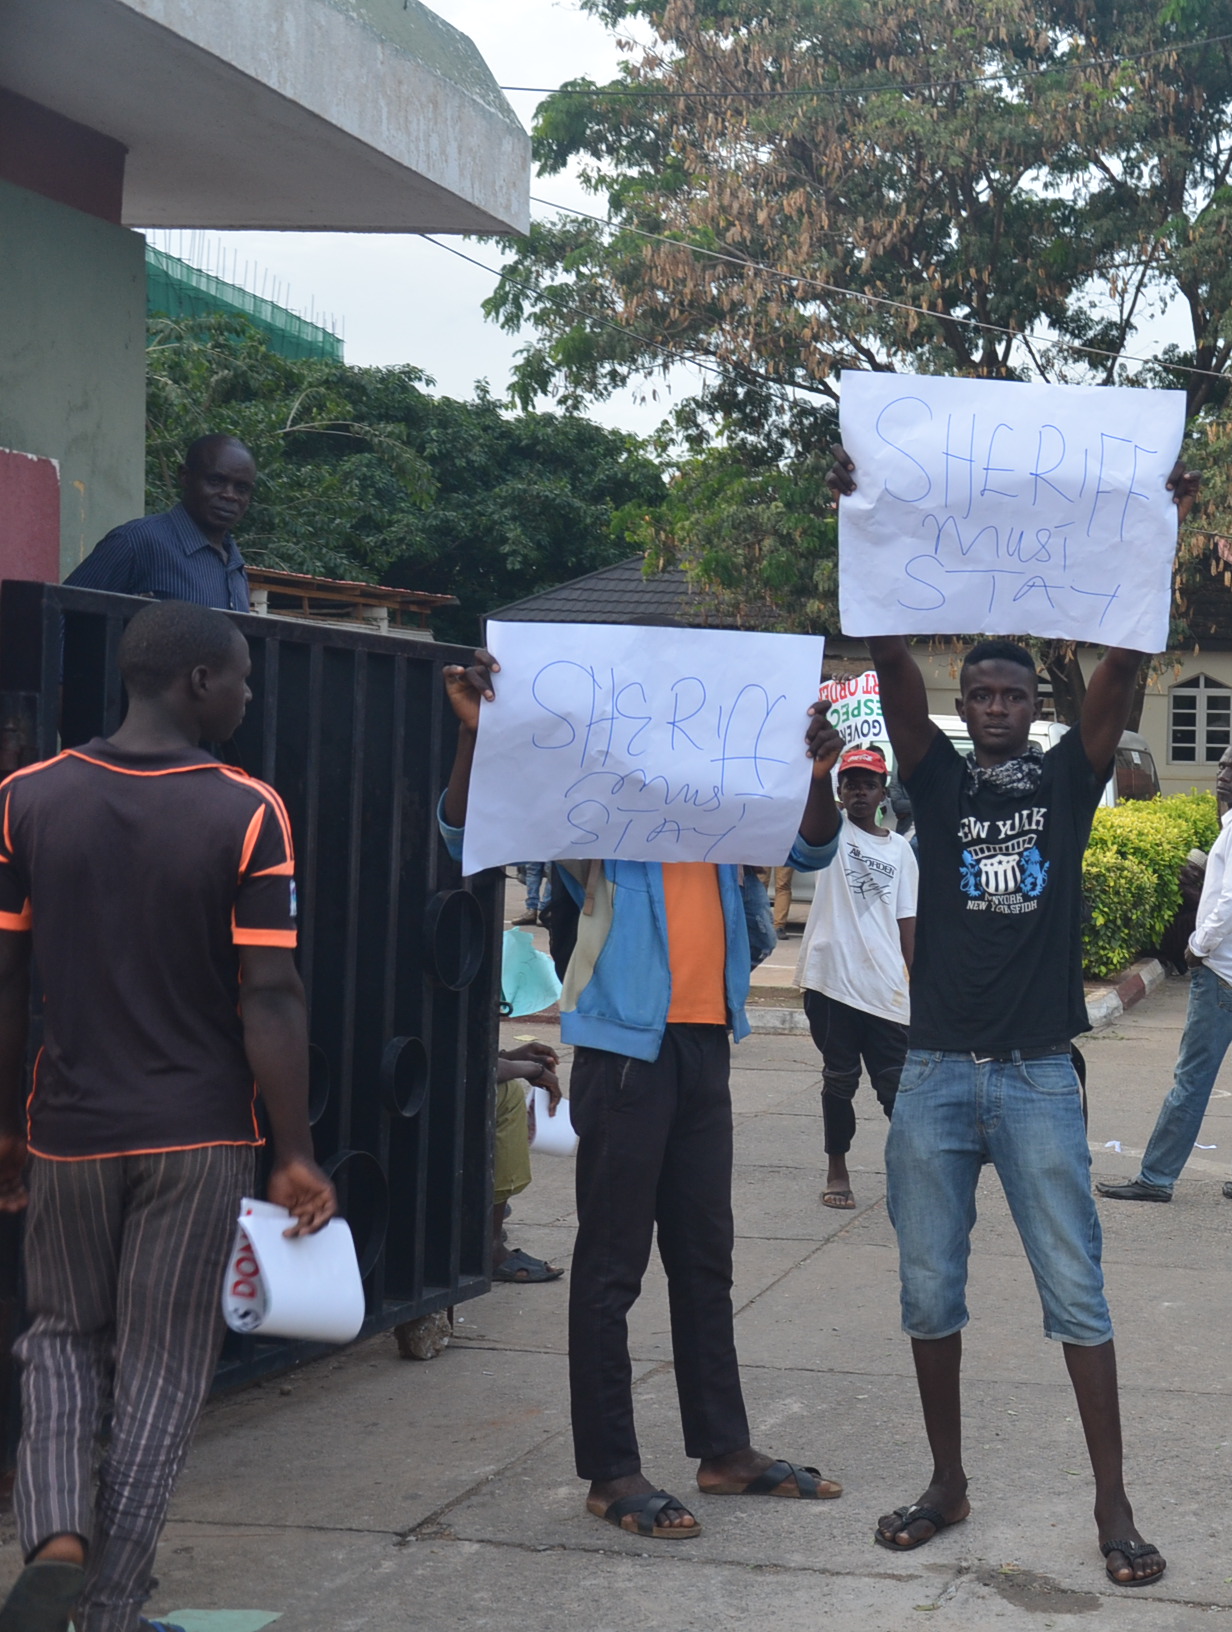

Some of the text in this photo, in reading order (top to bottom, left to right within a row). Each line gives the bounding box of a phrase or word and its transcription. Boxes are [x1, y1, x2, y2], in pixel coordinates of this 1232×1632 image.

[875, 396, 1158, 543] SHERIFF
[897, 554, 1121, 627] STAY
[566, 798, 738, 863] STAY
[957, 816, 991, 843] EW
